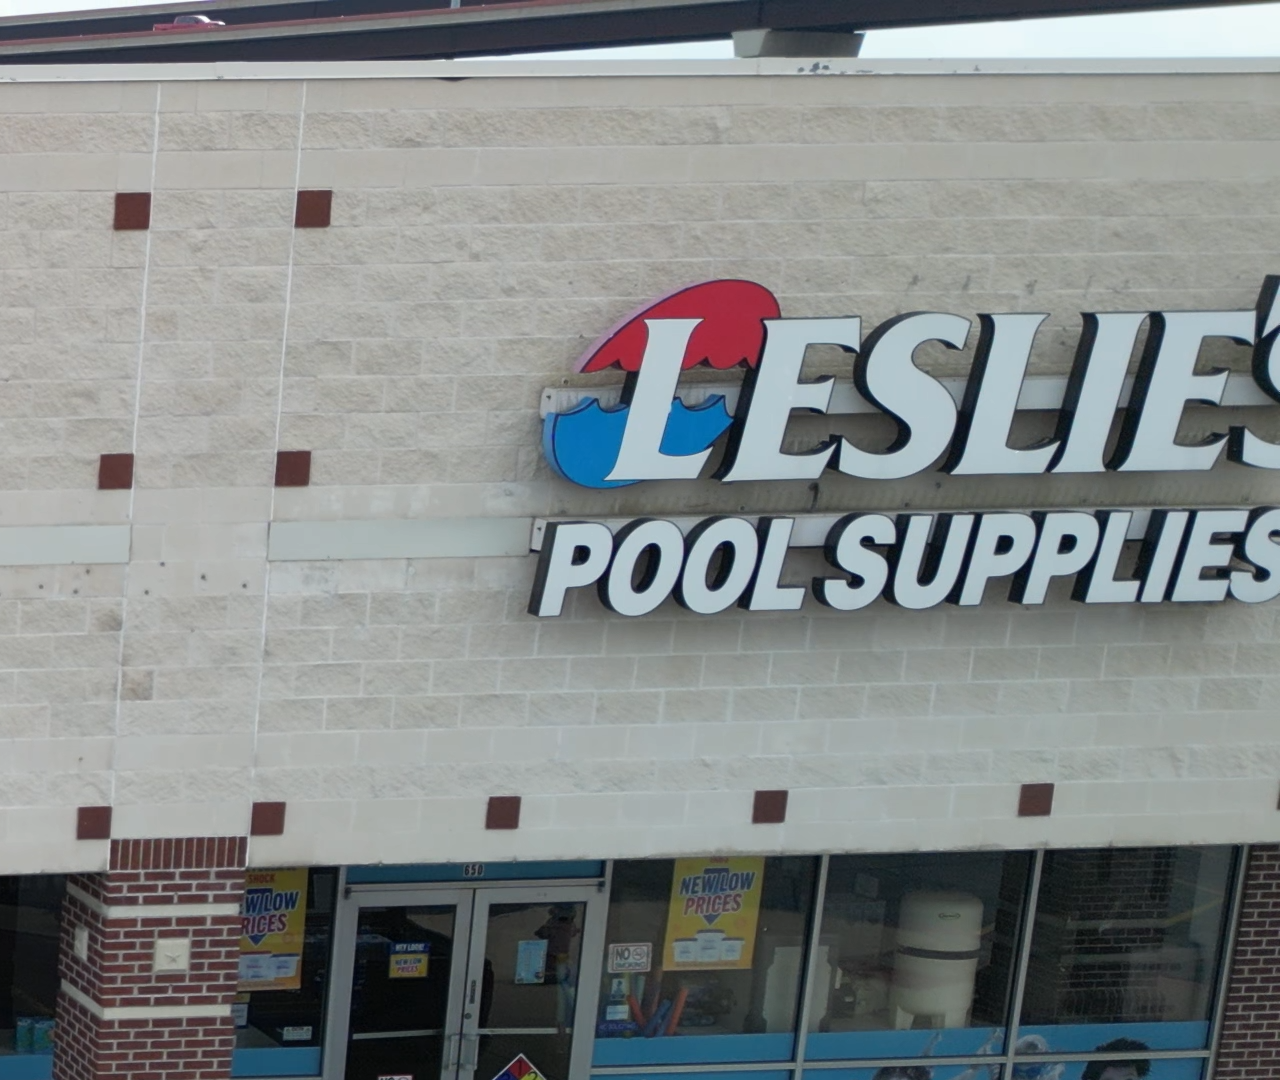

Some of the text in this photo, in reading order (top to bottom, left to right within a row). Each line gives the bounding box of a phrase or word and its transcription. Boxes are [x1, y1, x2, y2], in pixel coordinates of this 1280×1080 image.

[535, 515, 806, 617] POOL
[464, 865, 483, 876] 650
[680, 872, 755, 895] NEW LOW
[263, 891, 299, 912] LOW
[683, 894, 742, 916] PRICES
[241, 914, 288, 934] RICES
[616, 948, 630, 960] NO
[615, 961, 646, 969] SMOKING
[517, 1060, 523, 1077] 1
